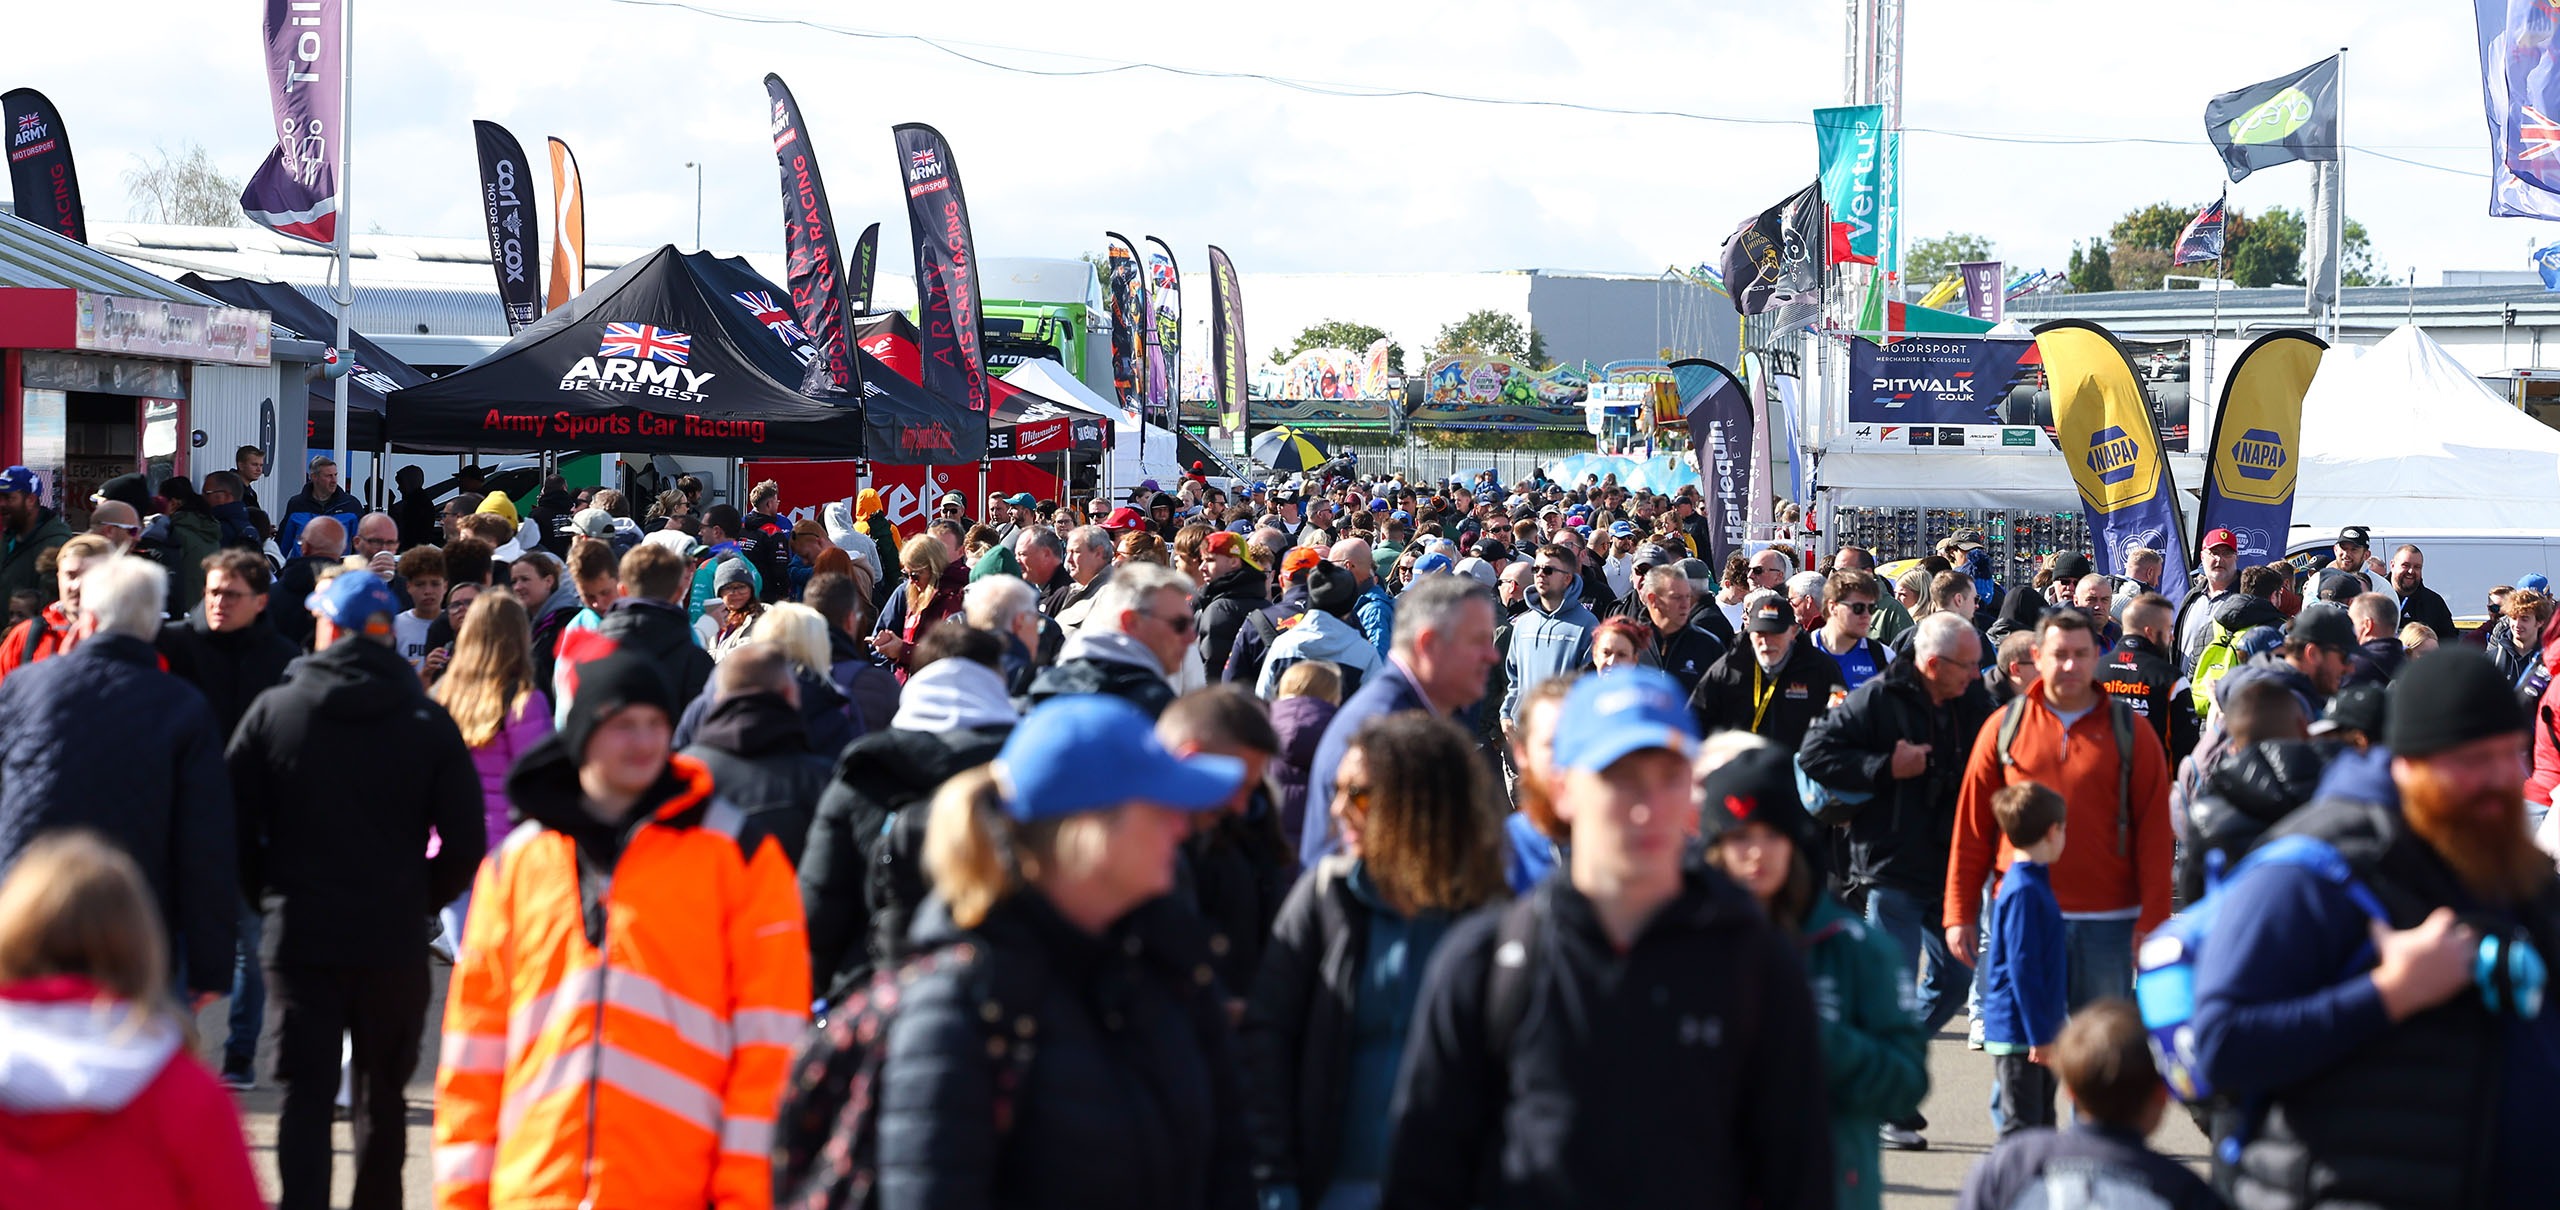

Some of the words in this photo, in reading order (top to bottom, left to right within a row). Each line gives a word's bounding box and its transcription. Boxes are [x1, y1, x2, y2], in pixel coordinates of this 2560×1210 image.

[286, 2, 320, 92] Toil
[12, 140, 54, 161] MOTORSPORT
[15, 124, 47, 146] ARMY
[910, 161, 941, 182] ARMY
[910, 179, 948, 197] MOTORSPORT
[1847, 137, 1875, 240] Vertu
[51, 163, 76, 239] RACING
[487, 183, 499, 226] MOTOR
[793, 155, 823, 240] RACING
[492, 226, 503, 263] SPORT
[944, 201, 967, 279] RACING
[786, 222, 816, 337] ARMY
[814, 245, 834, 292] CAR
[860, 242, 871, 308] ATOR
[955, 283, 970, 326] CAR
[1980, 270, 1993, 318] ilets
[928, 262, 954, 367] ARMY
[1880, 344, 1967, 354] MOTORSPORT
[562, 356, 716, 393] ARMY
[959, 331, 984, 411] SPORTS
[1872, 378, 1974, 392] PITWALK
[559, 379, 588, 391] BE
[597, 380, 640, 395] THE
[646, 384, 709, 403] BEST
[1935, 393, 1974, 401] .CO.UK
[483, 409, 548, 438] Army
[554, 412, 629, 438] Sports
[637, 411, 677, 436] Car
[685, 414, 766, 443] Racing
[1020, 424, 1061, 444] Milwaukee
[2095, 441, 2131, 471] NAPA
[2241, 447, 2278, 466] NAPA
[1709, 420, 1742, 545] Harlequin
[2103, 680, 2150, 695] alfords
